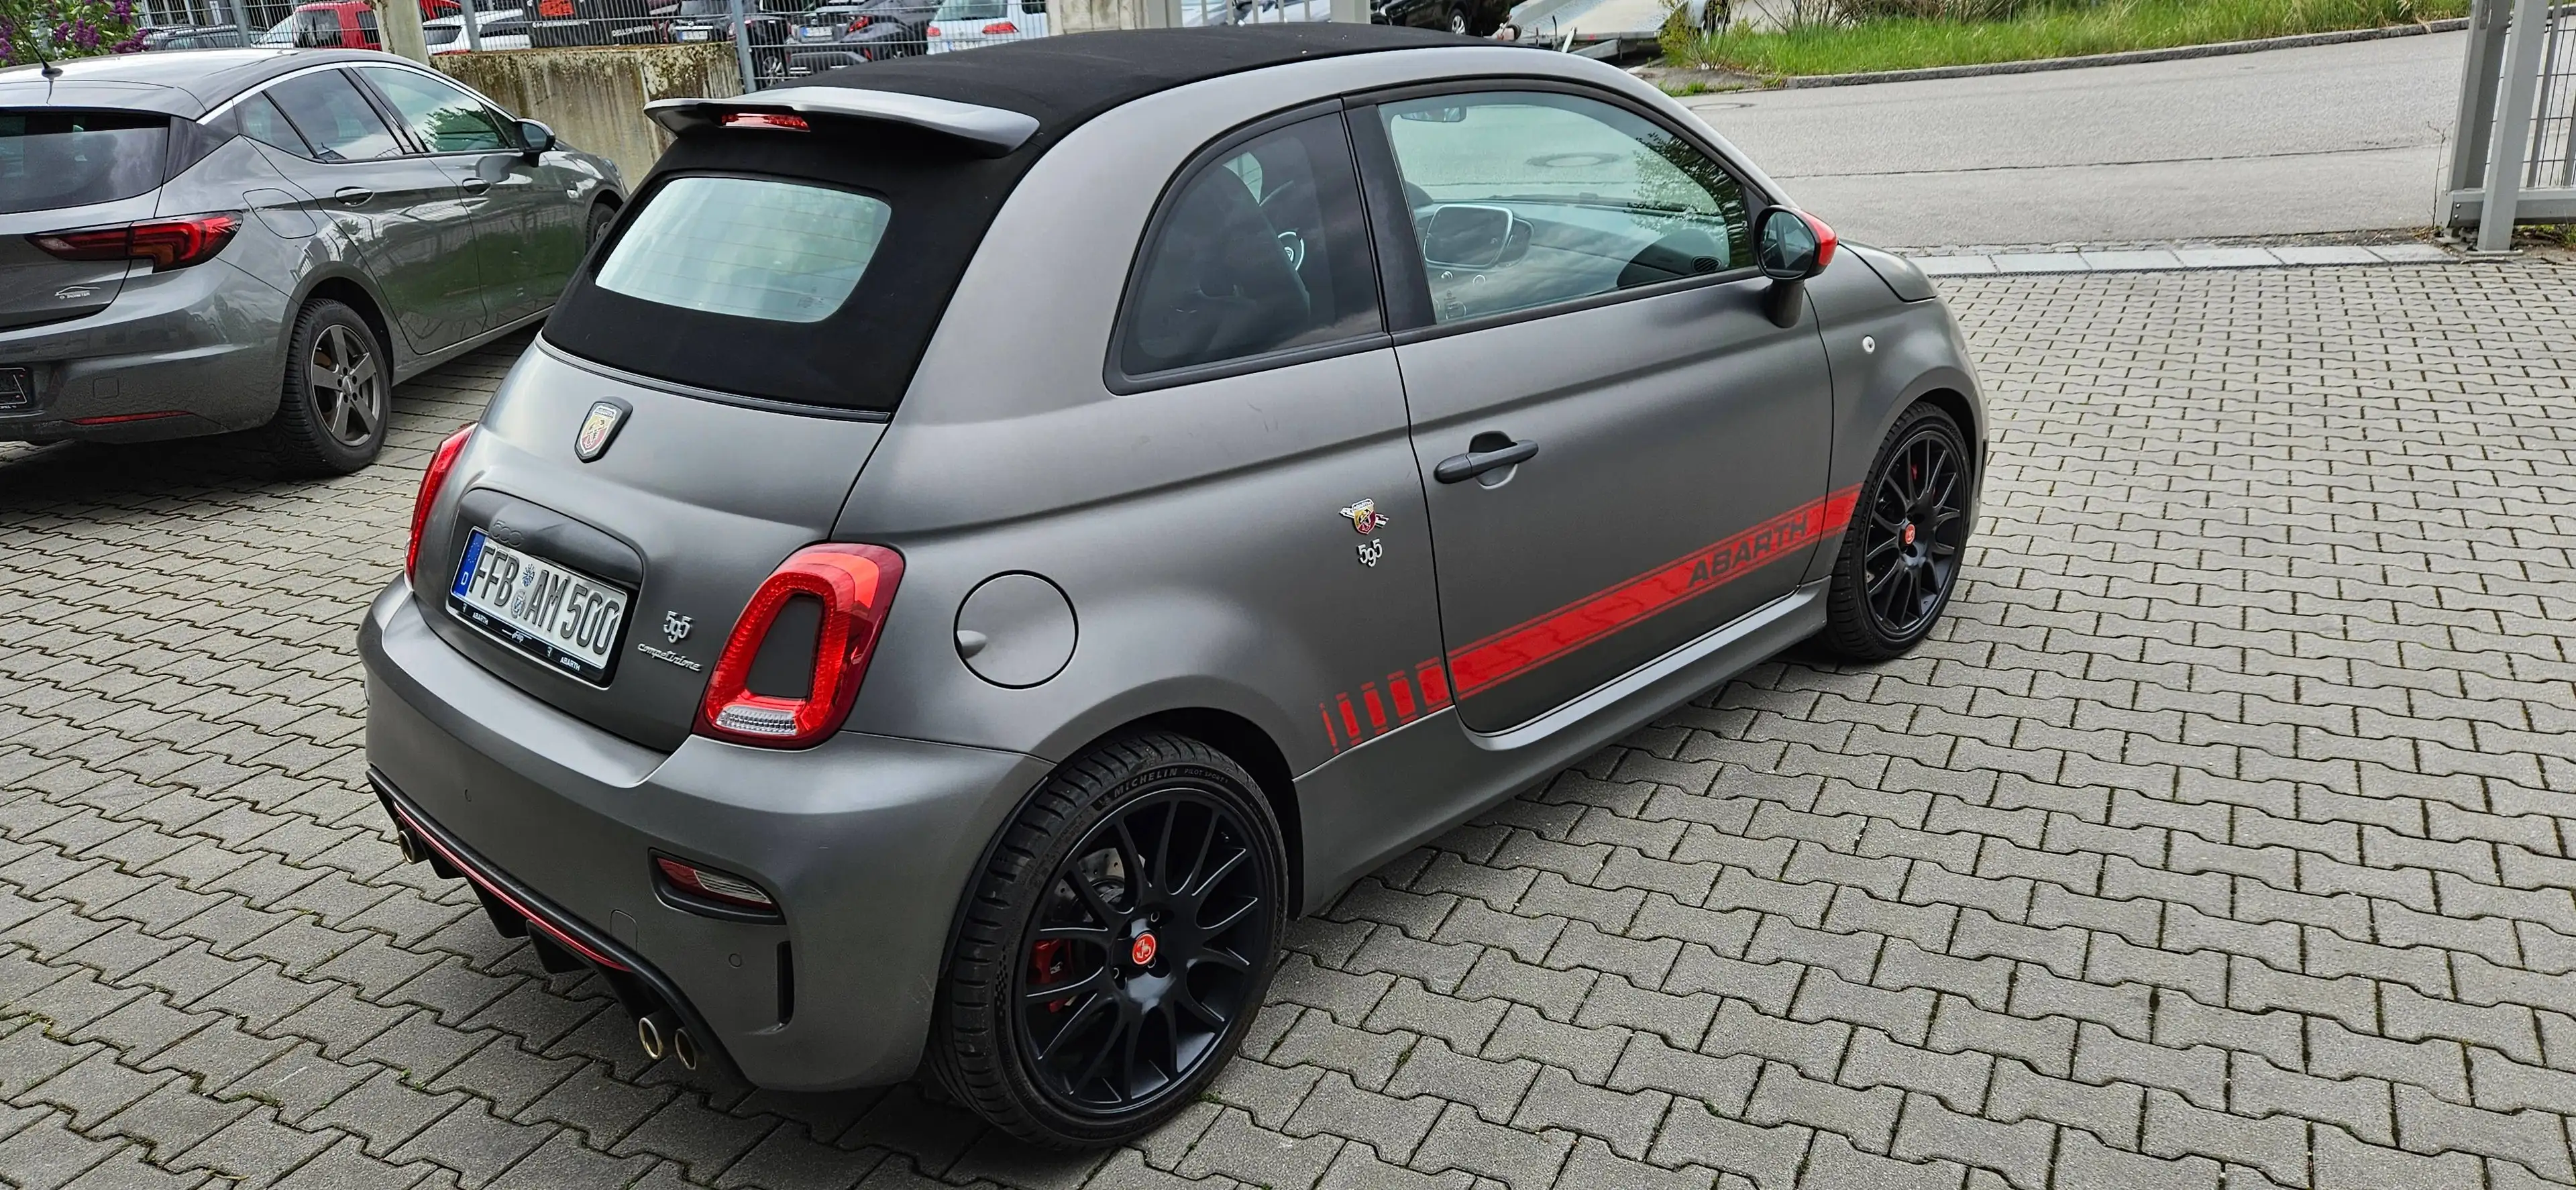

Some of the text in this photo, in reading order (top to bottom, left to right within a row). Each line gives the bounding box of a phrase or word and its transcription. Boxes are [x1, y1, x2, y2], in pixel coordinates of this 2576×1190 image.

[1357, 538, 1383, 567] 595
[1688, 512, 1808, 588] ABARTH
[461, 571, 469, 586] D
[468, 545, 521, 608] FFB
[524, 569, 570, 632] AM
[561, 585, 620, 656] 500
[472, 612, 581, 671] ABARTH ABARTH
[663, 611, 696, 643] 595
[1114, 768, 1178, 798] MICHELIN
